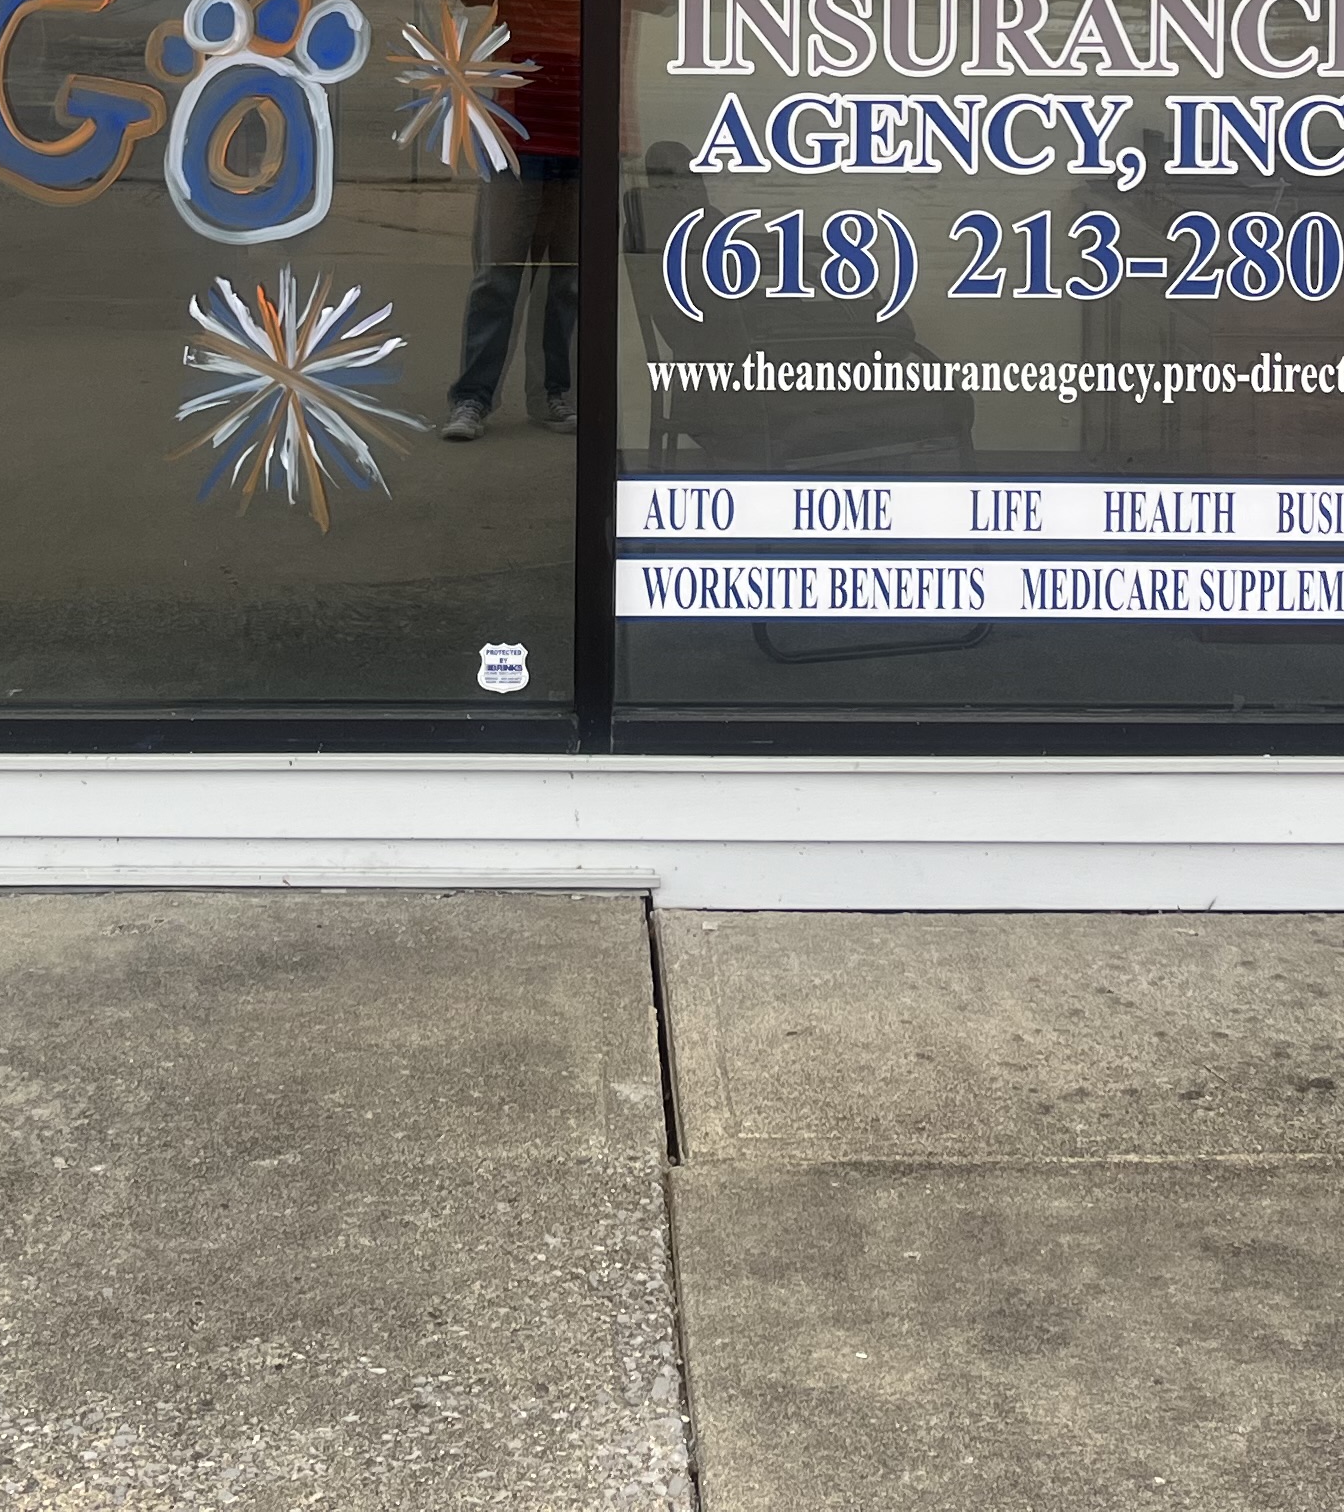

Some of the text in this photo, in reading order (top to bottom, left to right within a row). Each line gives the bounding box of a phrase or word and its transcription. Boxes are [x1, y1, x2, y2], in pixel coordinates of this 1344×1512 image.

[689, 93, 1148, 191] AGENCY,
[662, 207, 919, 322] (618)
[643, 488, 735, 531] AUTO
[793, 488, 892, 532] HOME
[970, 489, 1043, 532] LIFE
[1103, 491, 1236, 534] HEALTH
[641, 566, 818, 610] WORKSITE
[828, 567, 985, 611] BENEFITS
[1020, 568, 1190, 611] MEDICARE
